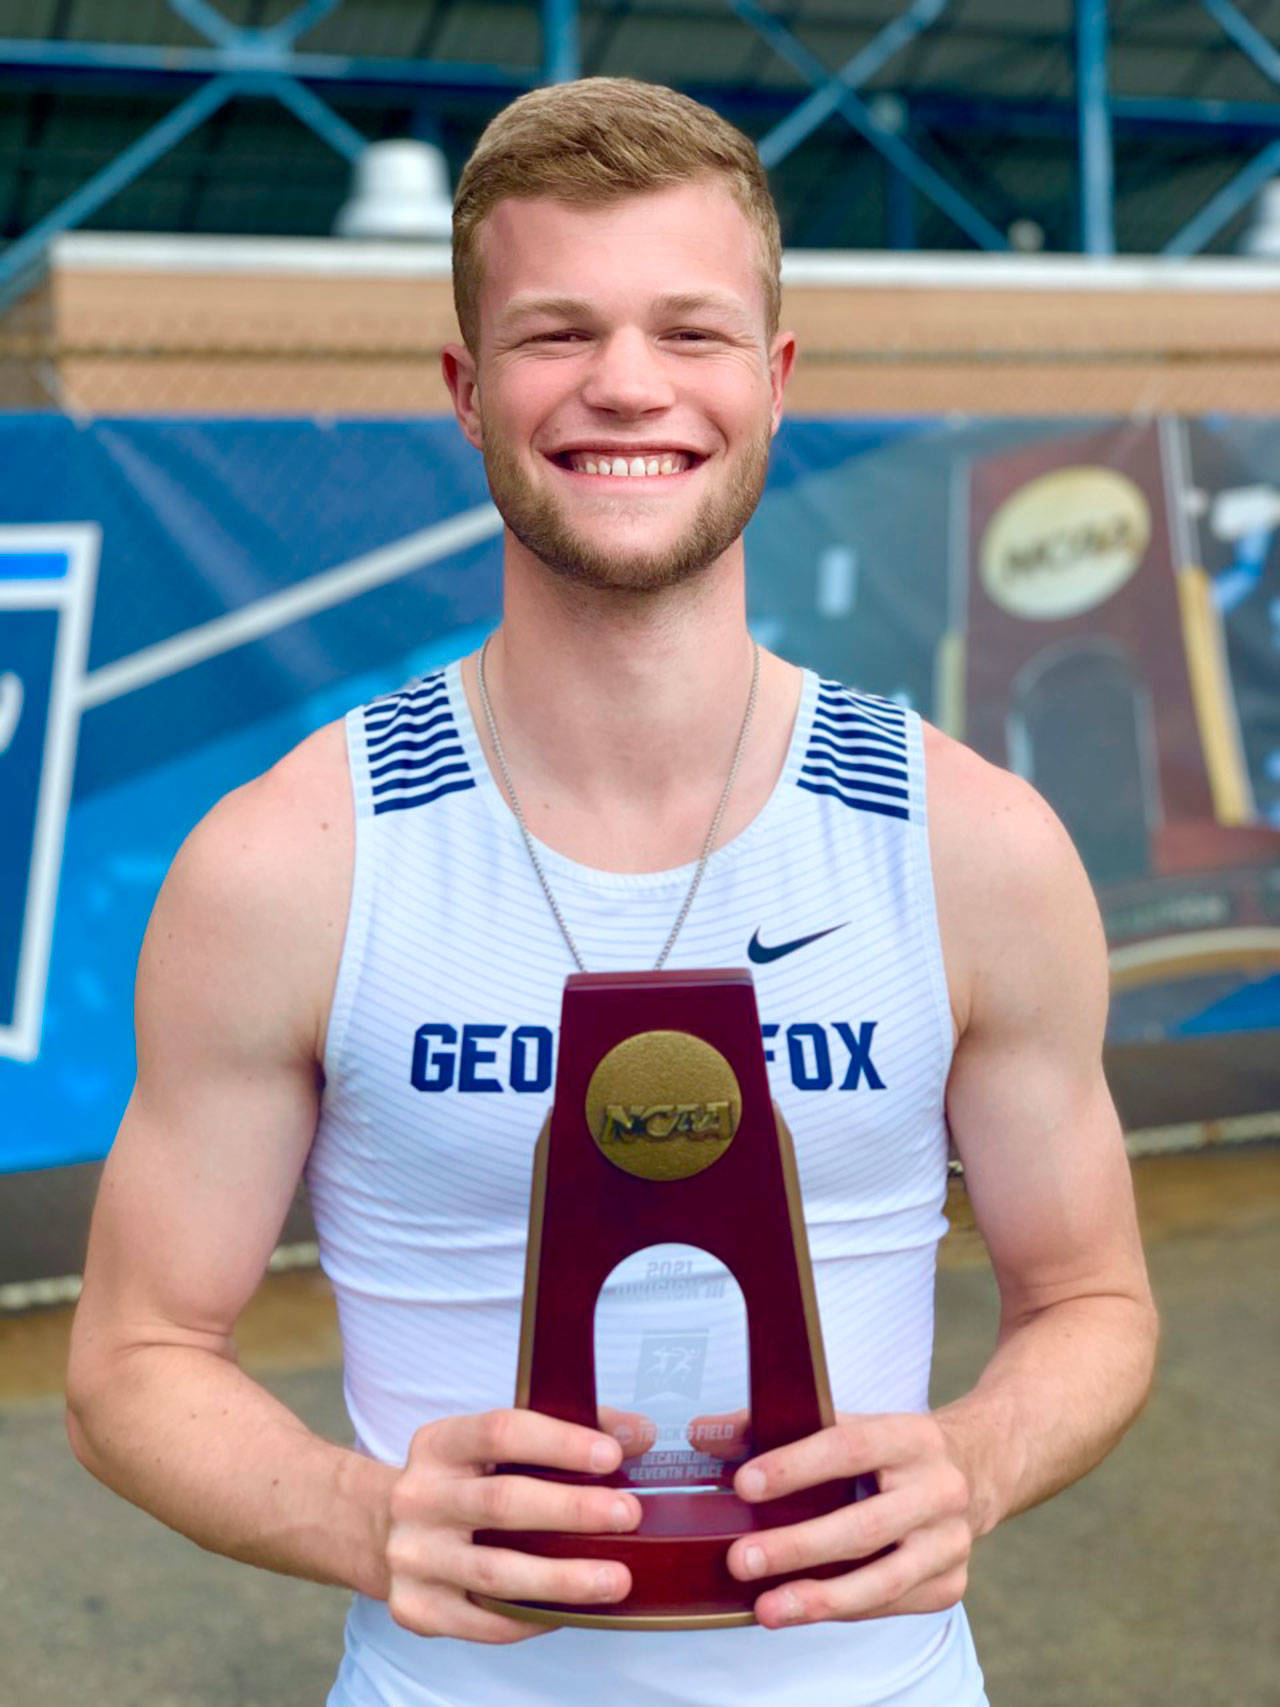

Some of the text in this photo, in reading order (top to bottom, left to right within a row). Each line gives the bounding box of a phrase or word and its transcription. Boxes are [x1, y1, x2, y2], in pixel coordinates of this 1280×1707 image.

[410, 1023, 554, 1093] GEO
[602, 1101, 732, 1142] NCAA
[646, 1260, 693, 1279] 2021
[696, 1424, 735, 1440] FIELD
[641, 1451, 711, 1465] DECATHLON
[629, 1464, 724, 1480] SEVENTH PLACE
